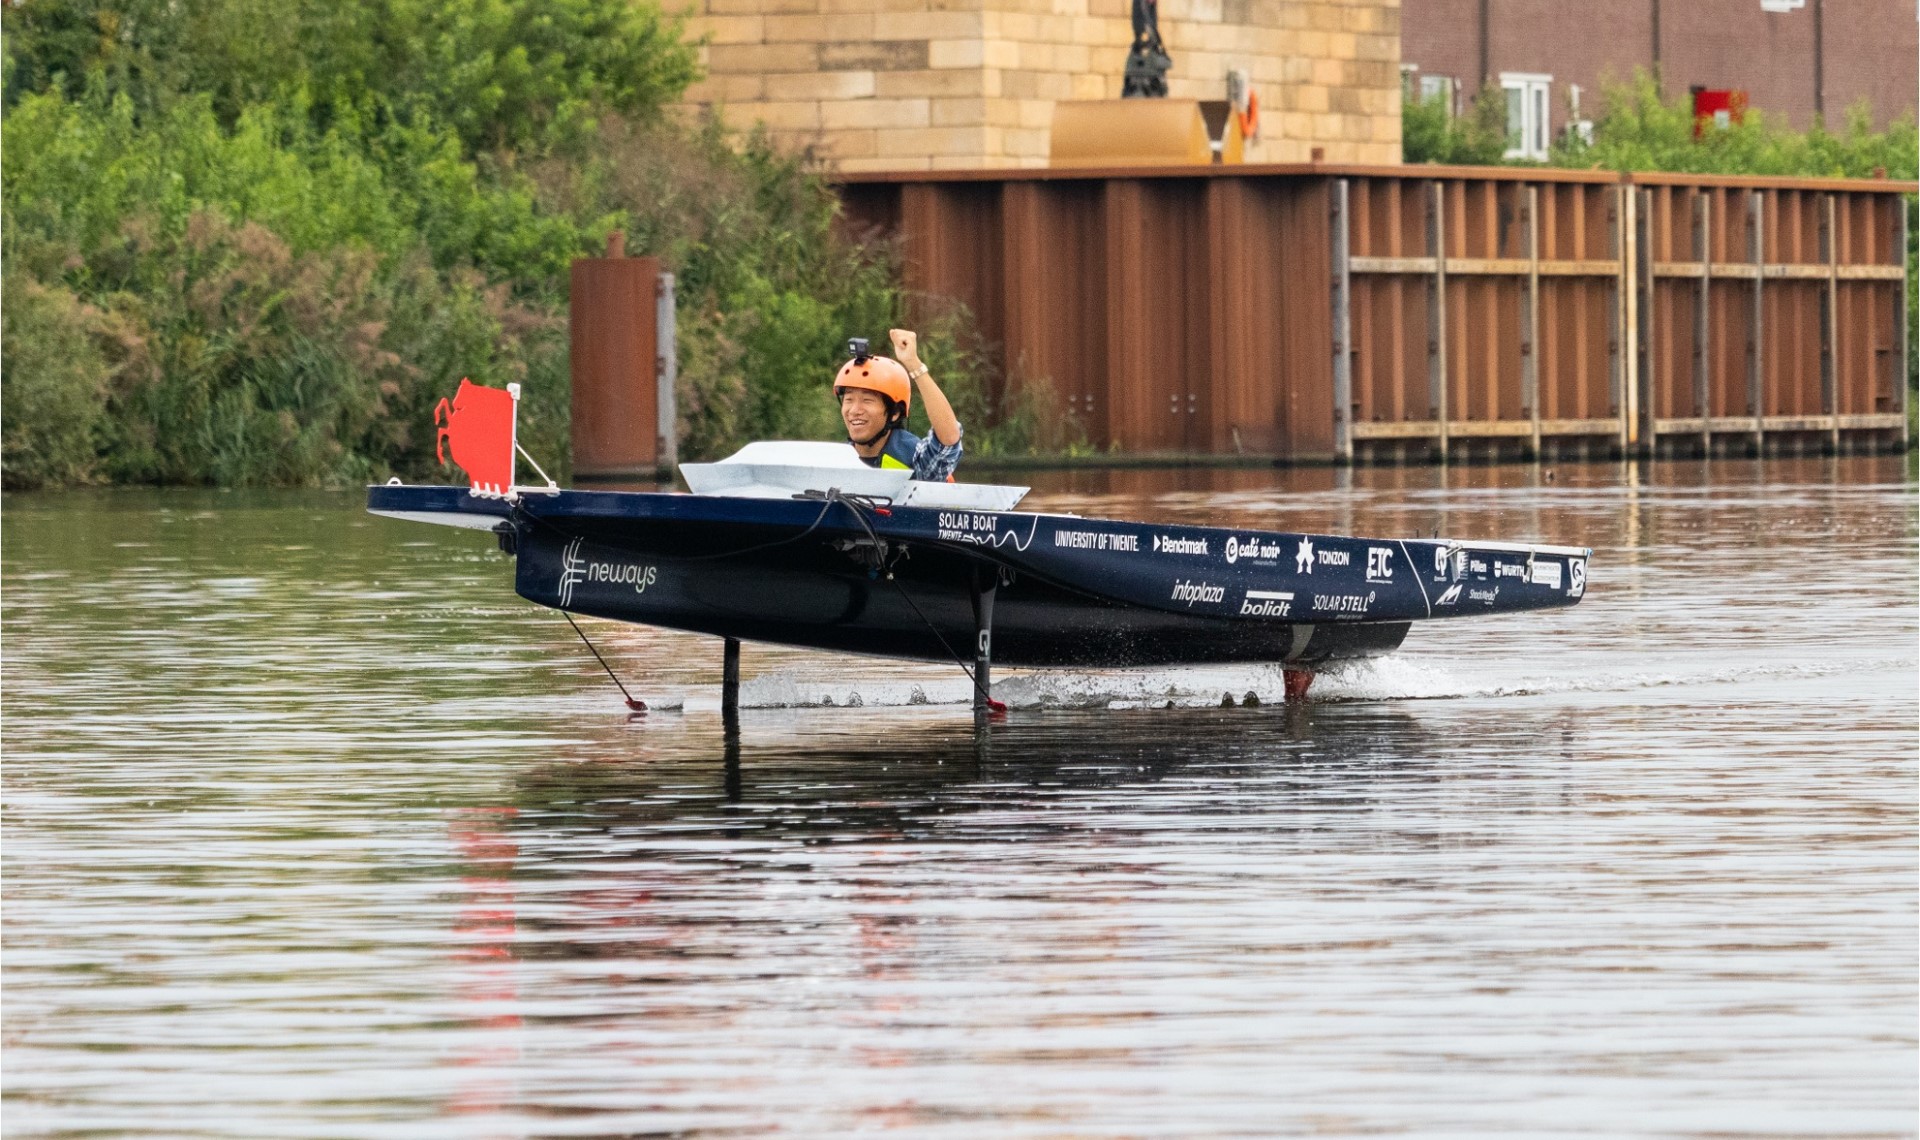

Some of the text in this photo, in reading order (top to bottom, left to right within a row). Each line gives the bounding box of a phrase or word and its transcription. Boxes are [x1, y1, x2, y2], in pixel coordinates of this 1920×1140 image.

[939, 513, 998, 531] SOLAR BOAT
[938, 529, 962, 541] TWENTE
[1055, 530, 1098, 549] UNIVERSITY
[1098, 533, 1109, 550] OF
[1162, 535, 1209, 555] Benchmark
[1239, 537, 1280, 559] café noir
[1318, 550, 1350, 566] TONZON
[1367, 547, 1394, 577] ETC
[588, 562, 657, 593] neways
[1171, 579, 1225, 607] infoplaza
[1312, 594, 1340, 611] SOLAR
[1240, 599, 1291, 617] bolidt
